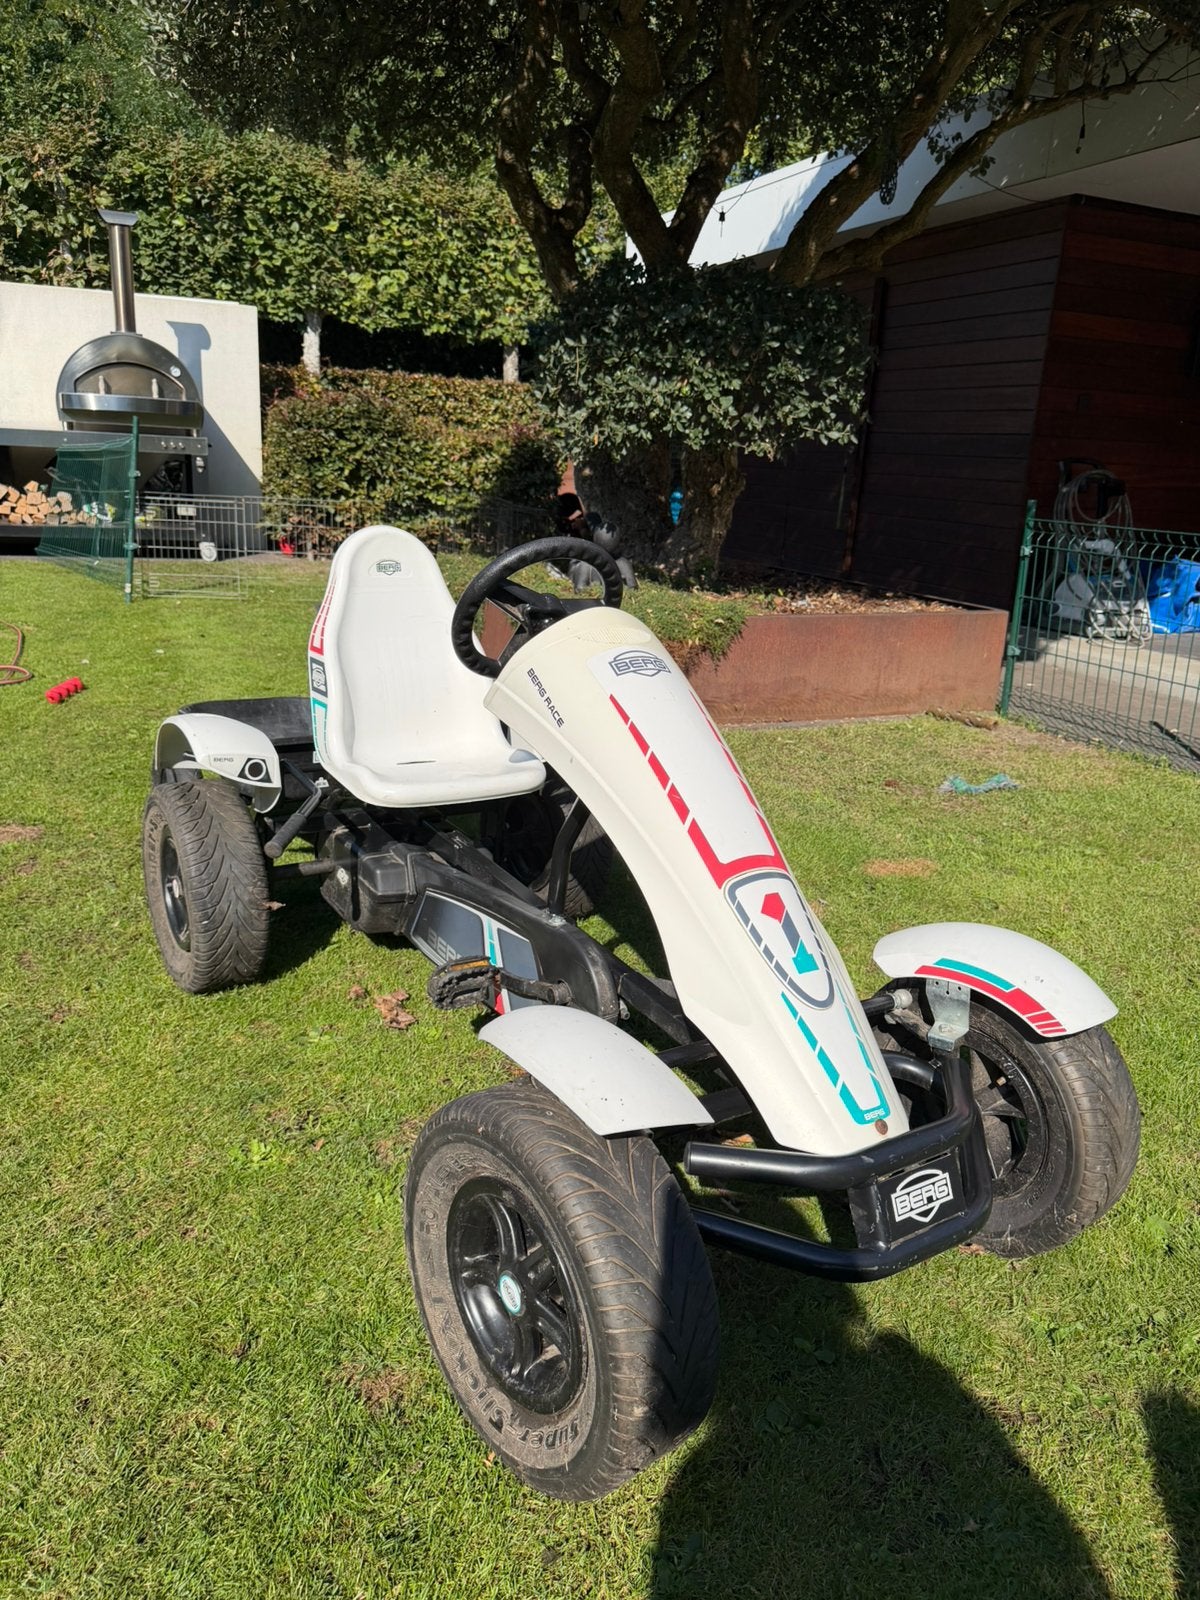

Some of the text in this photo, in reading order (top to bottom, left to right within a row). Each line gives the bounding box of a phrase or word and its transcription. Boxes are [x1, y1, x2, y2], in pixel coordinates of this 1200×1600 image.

[614, 659, 666, 672] BERG
[527, 668, 564, 728] BERG RACE
[864, 1108, 885, 1120] BERG
[895, 1179, 949, 1215] BERG
